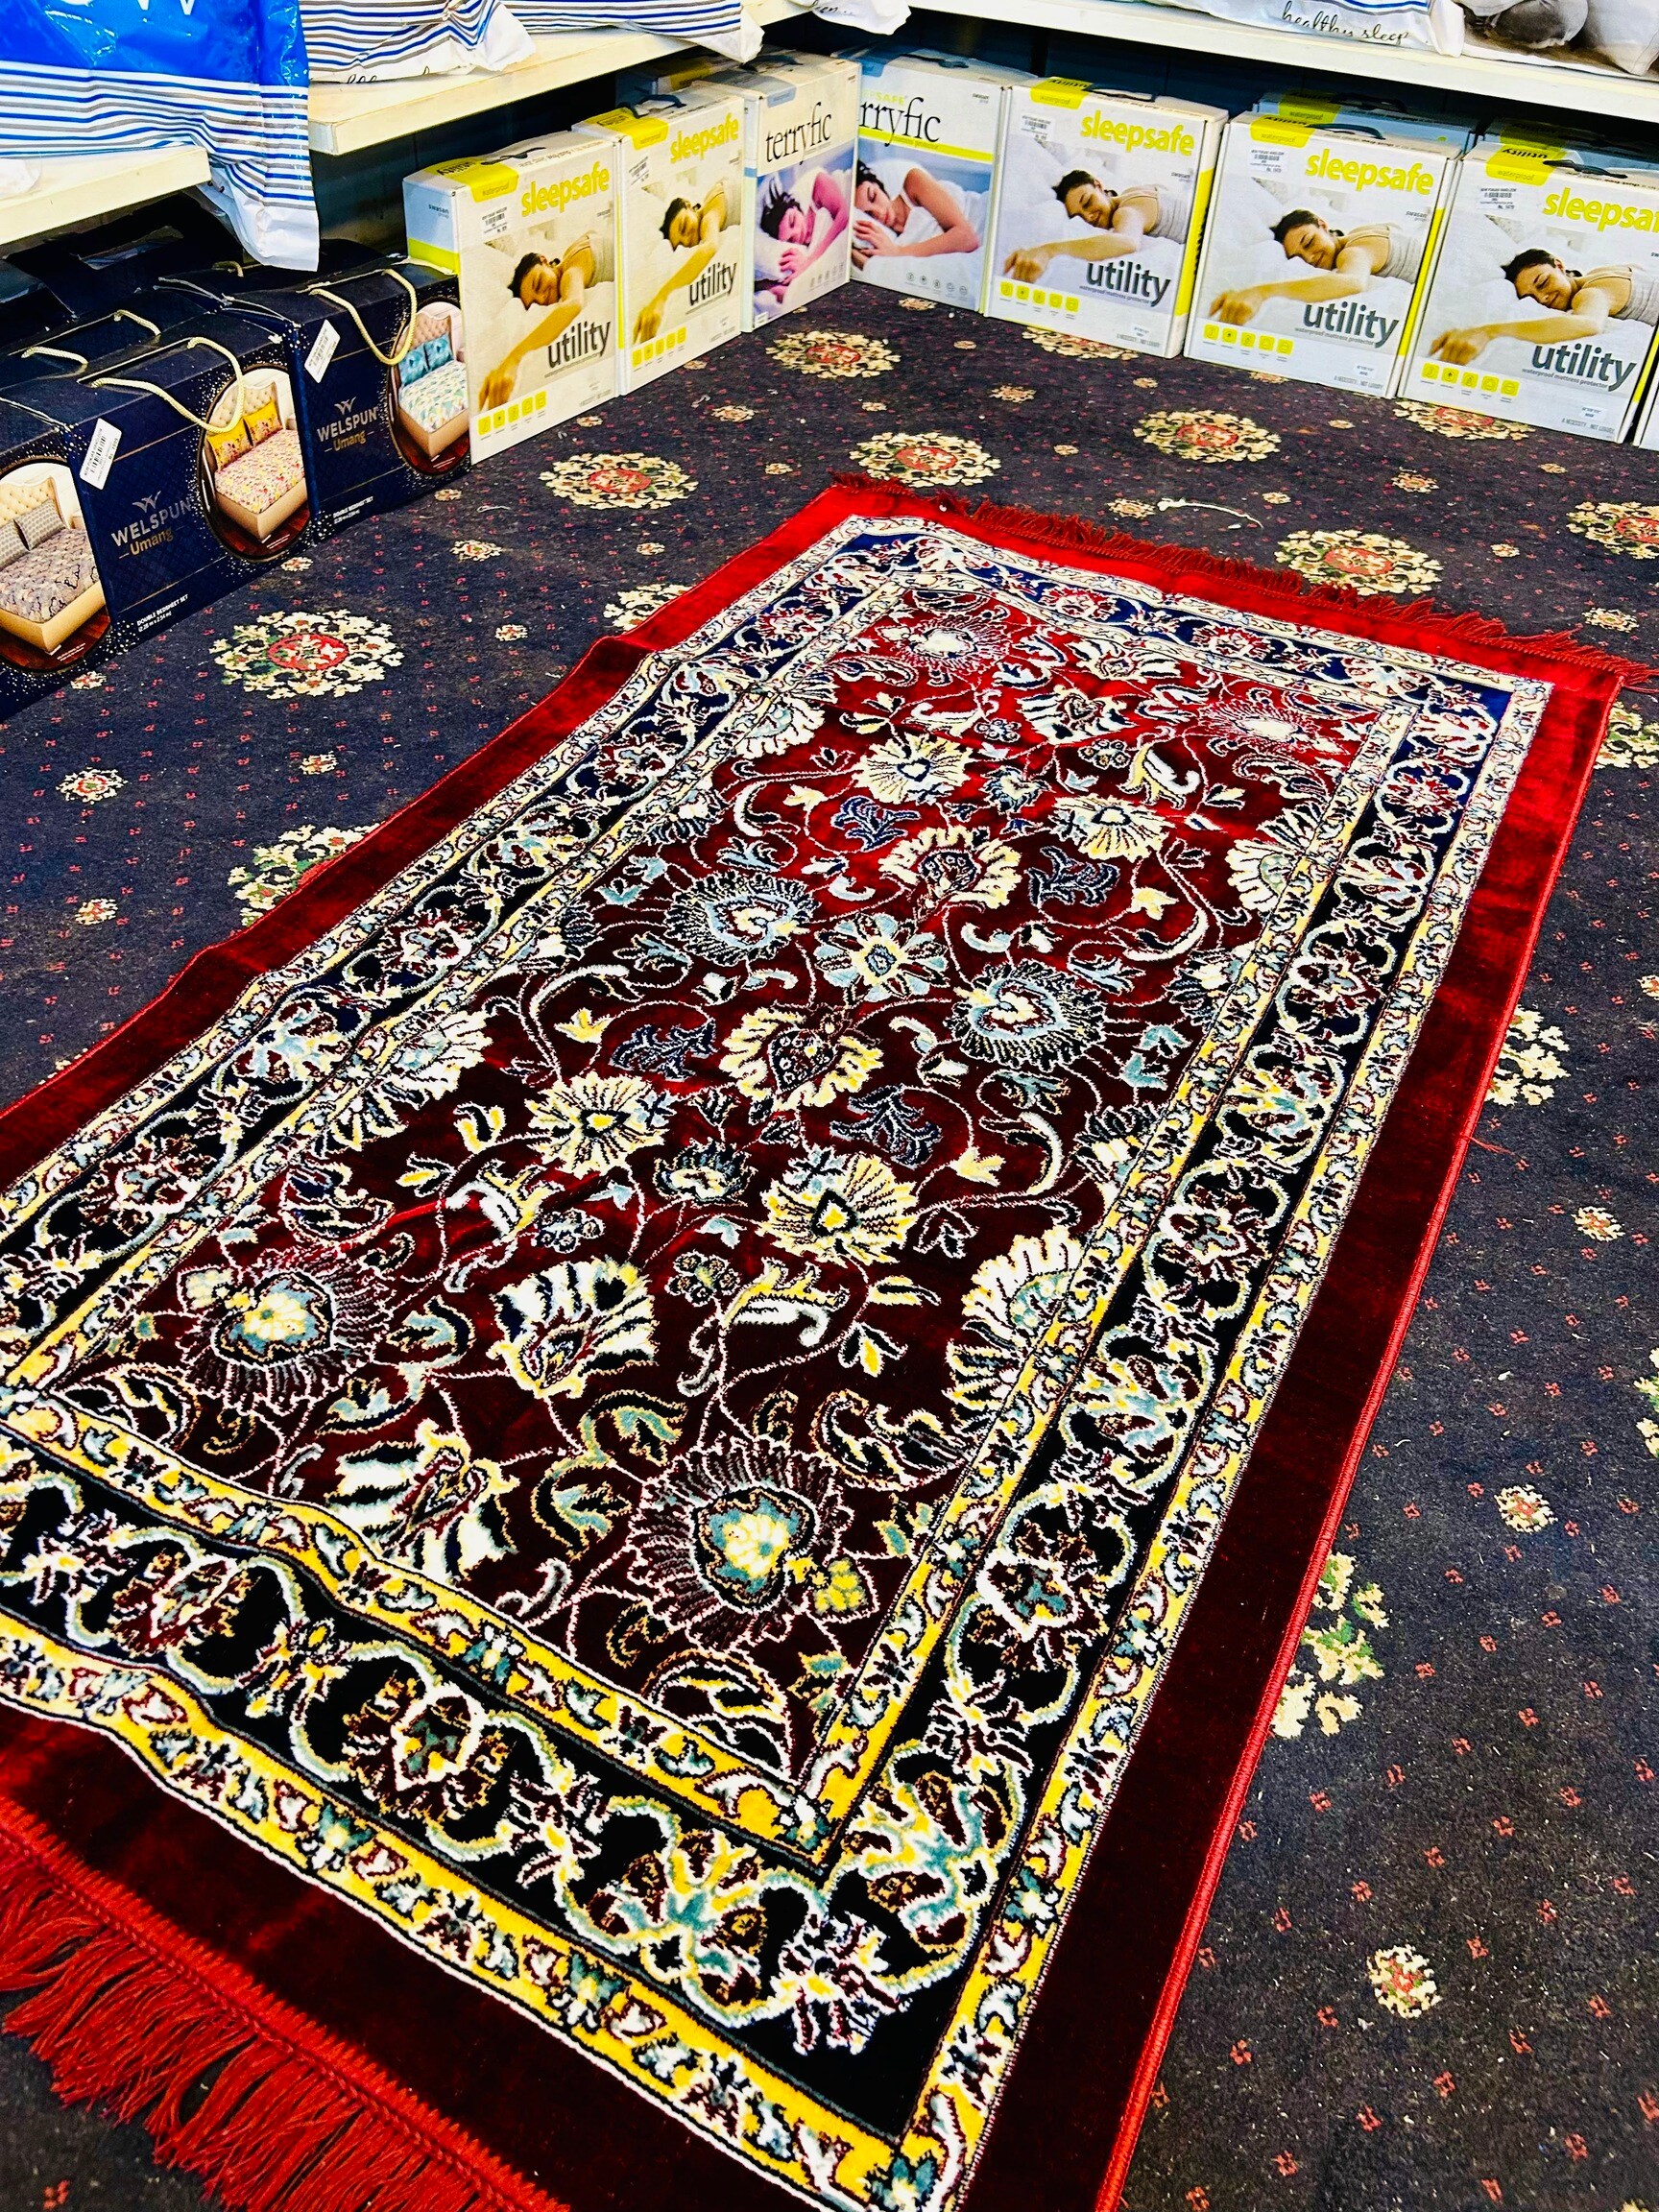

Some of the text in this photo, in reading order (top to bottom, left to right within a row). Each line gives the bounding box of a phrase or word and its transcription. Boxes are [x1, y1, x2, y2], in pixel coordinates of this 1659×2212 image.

[1361, 23, 1408, 45] sleep
[670, 112, 739, 164] sleepsafe
[765, 101, 831, 165] terryfic
[858, 96, 941, 147] rryfic
[1080, 109, 1194, 156] sleepsafe
[521, 160, 610, 217] sleepsafe
[1305, 149, 1434, 195] sleepsafe
[1542, 187, 1659, 233] sleepsa
[689, 261, 737, 306] utility
[1086, 260, 1171, 307] utility
[547, 321, 611, 368] utility
[1303, 301, 1400, 349] utility
[1531, 343, 1638, 392] utility
[317, 407, 378, 443] WELSPUN
[333, 430, 367, 451] Umang
[111, 497, 192, 547] WELSPUN
[130, 528, 174, 555] Umang
